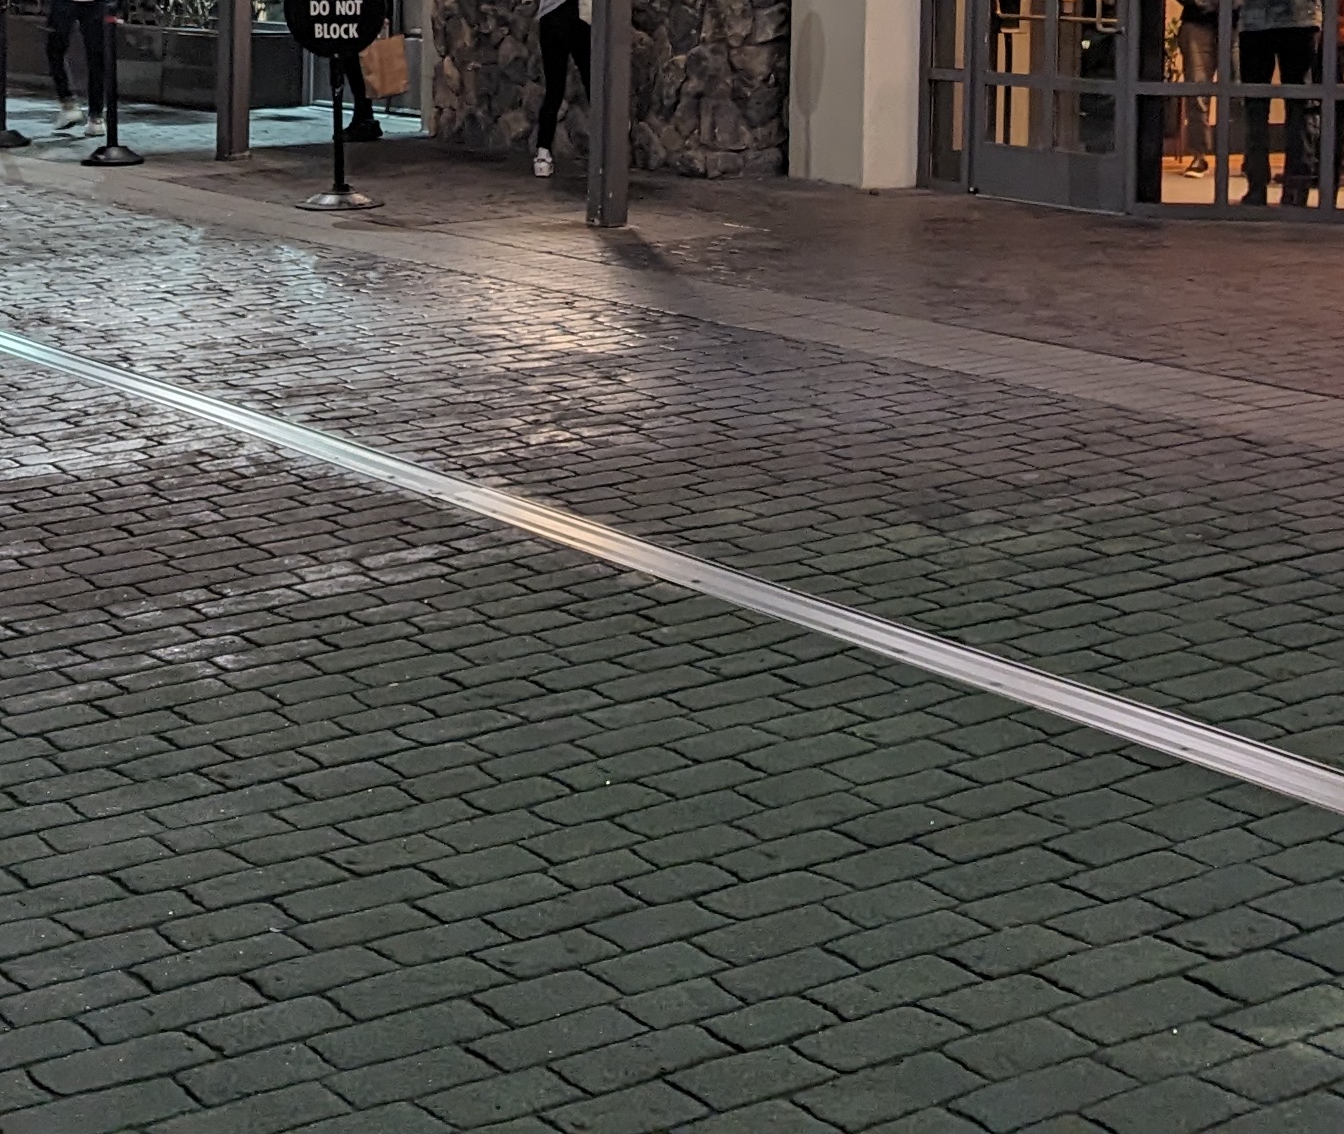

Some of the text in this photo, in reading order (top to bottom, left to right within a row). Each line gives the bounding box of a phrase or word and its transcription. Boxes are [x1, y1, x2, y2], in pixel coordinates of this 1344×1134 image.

[309, 0, 363, 16] DO NOT
[314, 23, 359, 39] BLOCK
